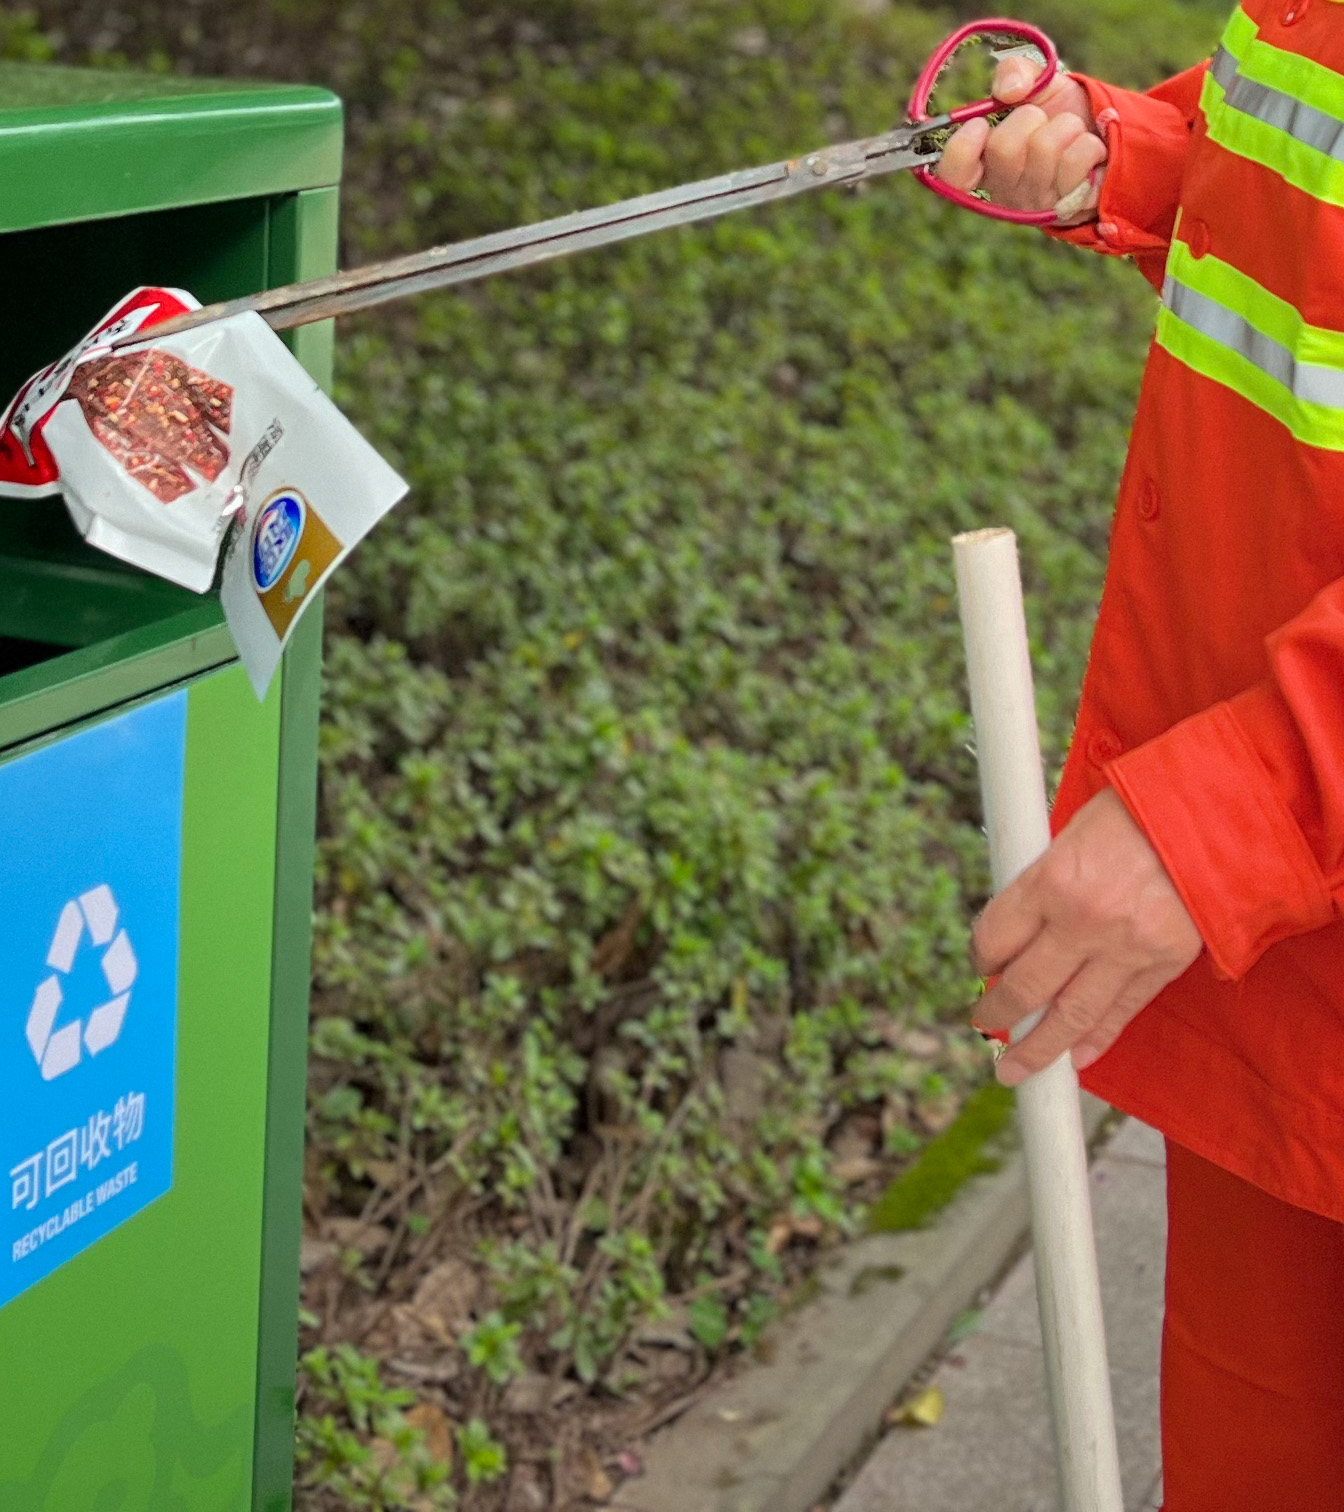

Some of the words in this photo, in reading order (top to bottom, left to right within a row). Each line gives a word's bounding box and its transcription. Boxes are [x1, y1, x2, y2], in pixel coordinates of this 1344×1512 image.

[9, 1091, 146, 1210] 可回收物
[12, 1191, 94, 1263] RECYCLABLE
[96, 1161, 138, 1206] WASTE
